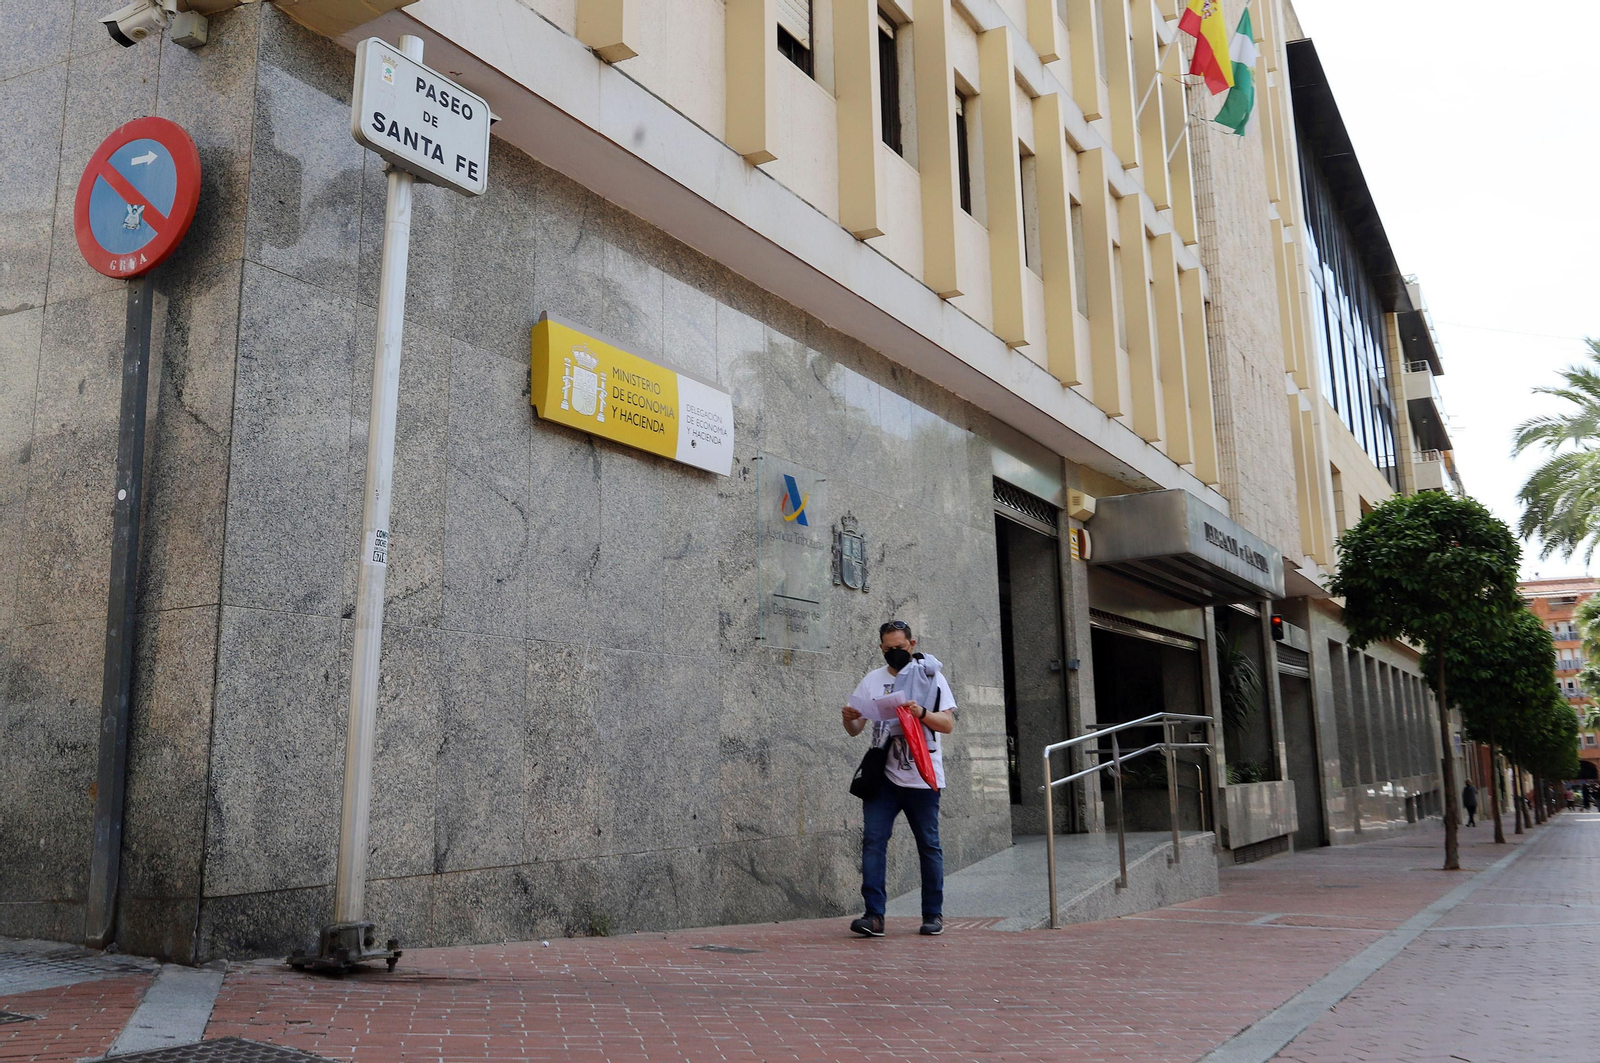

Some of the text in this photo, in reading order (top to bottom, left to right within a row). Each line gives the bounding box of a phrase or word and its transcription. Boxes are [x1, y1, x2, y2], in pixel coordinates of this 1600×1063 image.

[416, 76, 473, 121] PASEO
[423, 111, 439, 128] DE
[372, 111, 479, 182] SANTA FE
[612, 366, 661, 395] MINISTERIO
[612, 386, 625, 402] DE
[611, 405, 665, 435] Y HACIENDA
[686, 415, 694, 425] DE
[686, 426, 722, 446] Y HACIENDA
